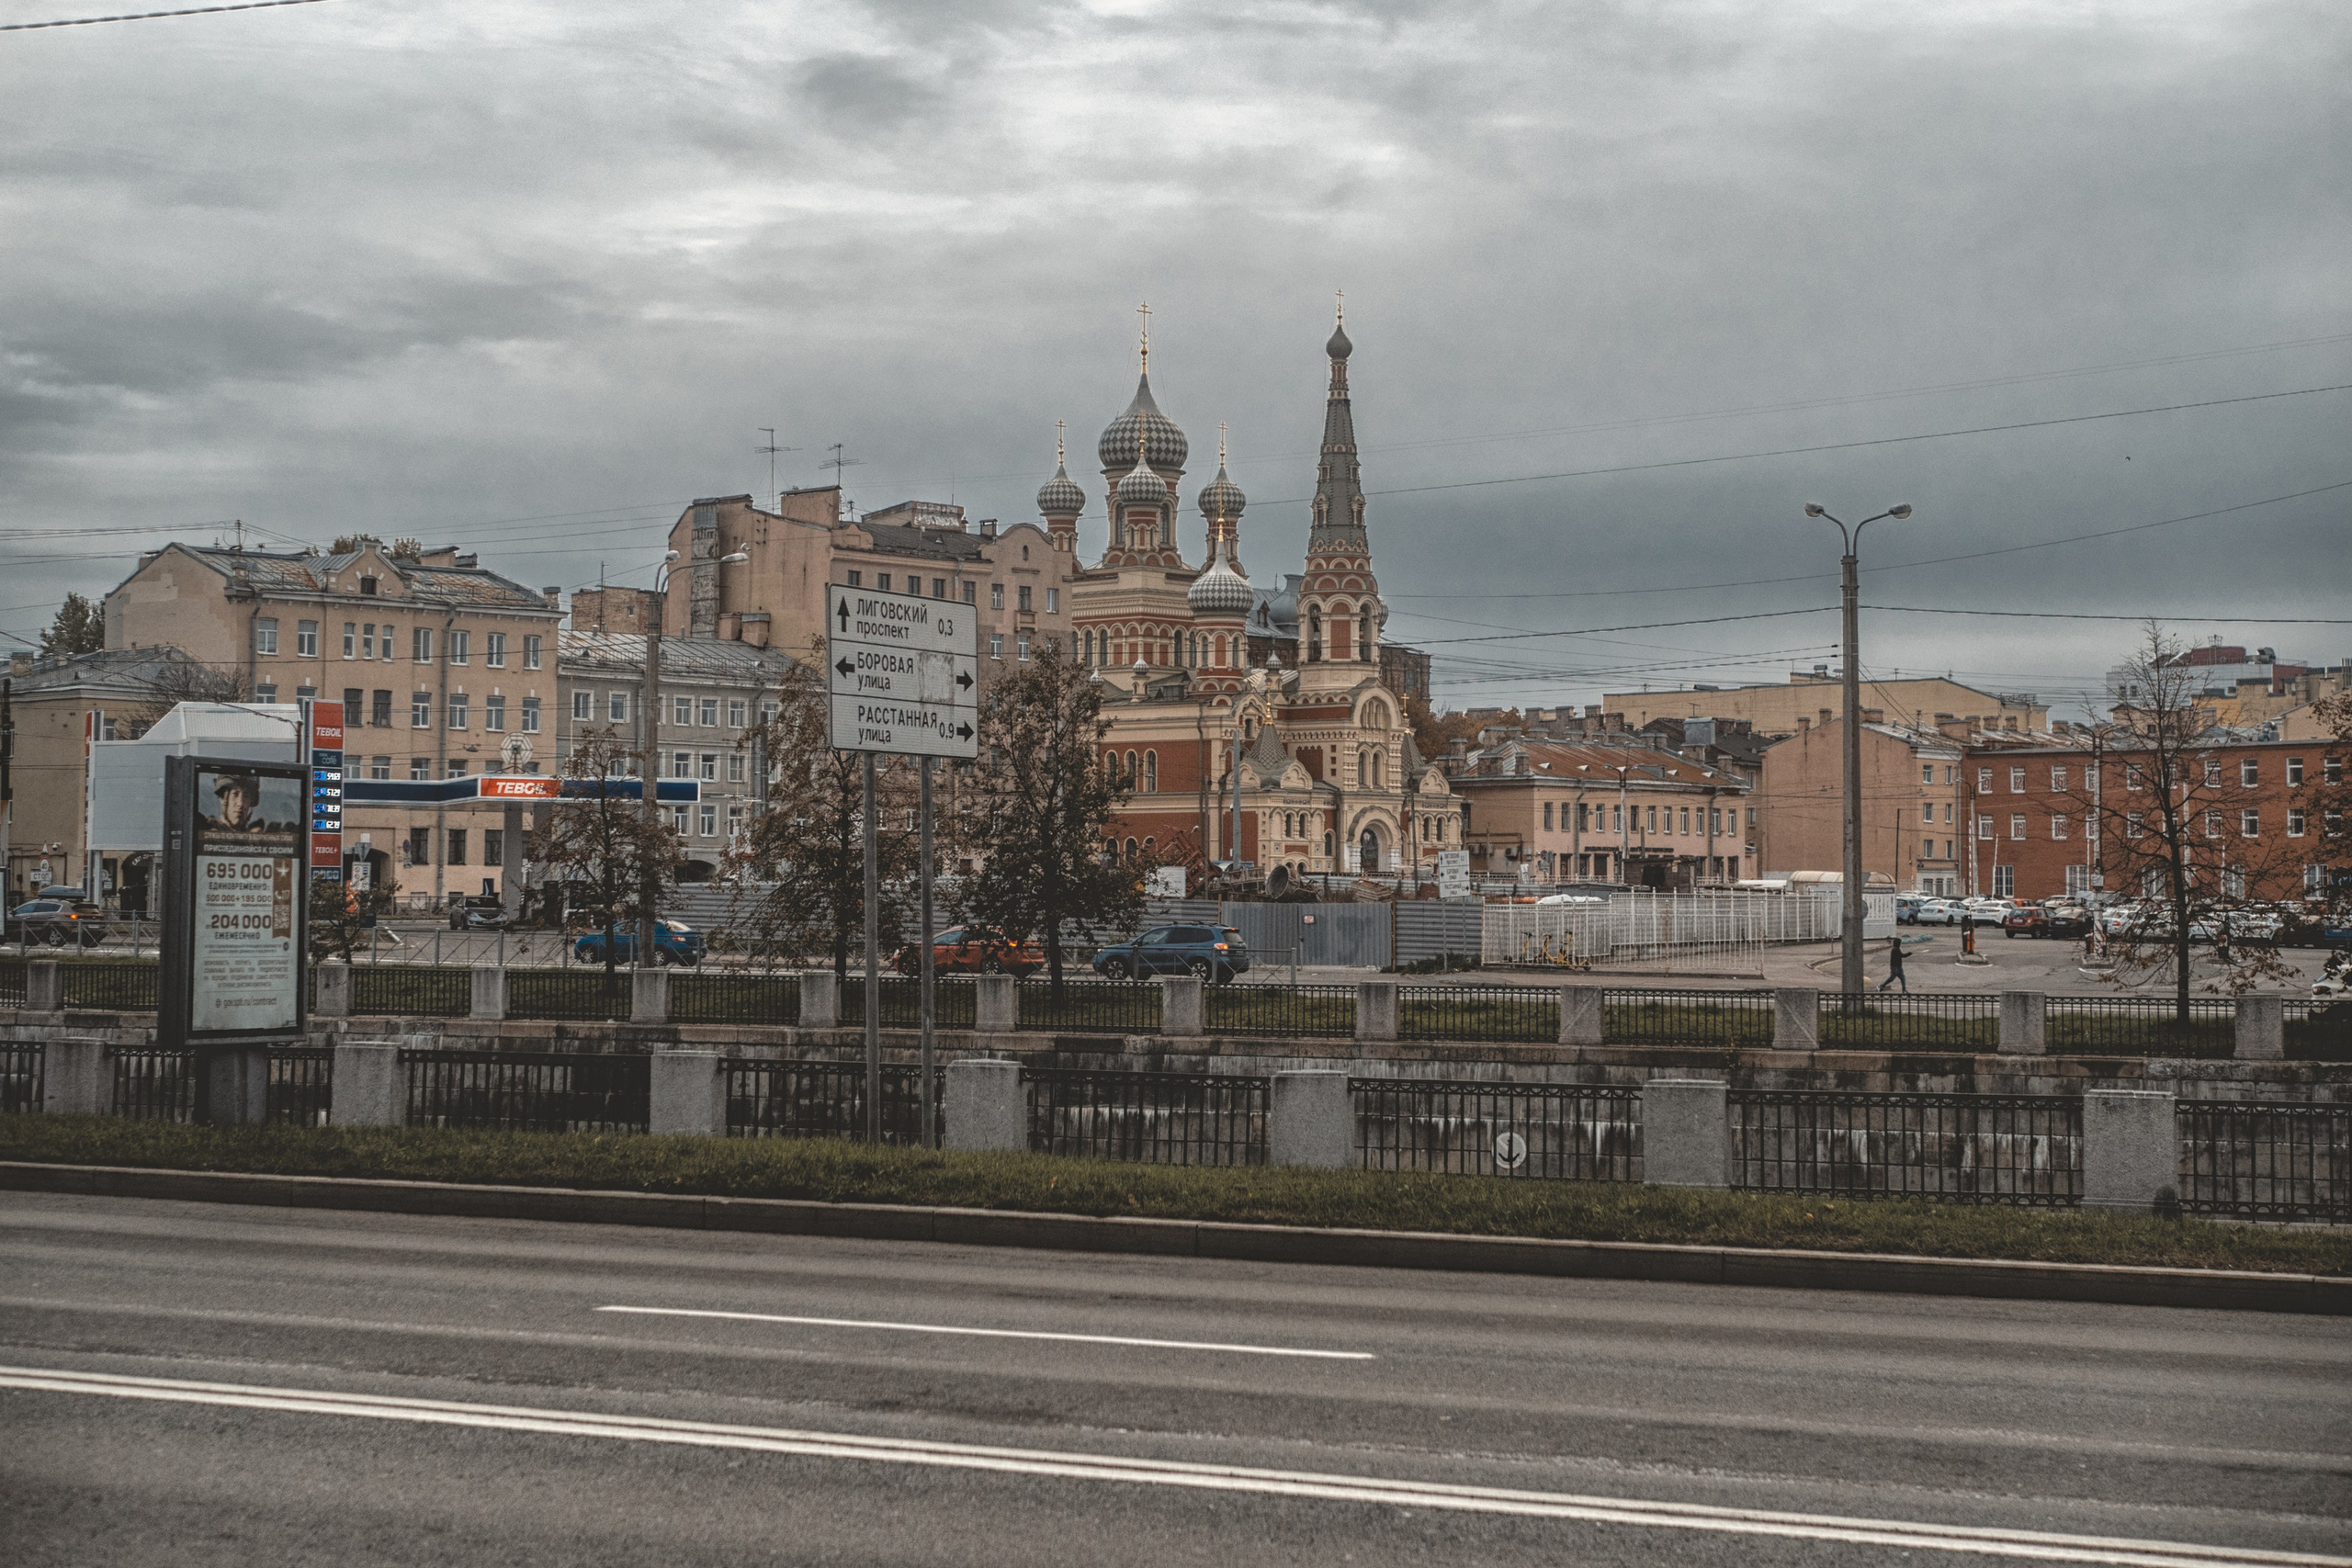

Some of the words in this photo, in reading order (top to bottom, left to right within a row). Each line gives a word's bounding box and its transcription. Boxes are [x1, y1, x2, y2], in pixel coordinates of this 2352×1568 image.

[856, 598, 928, 625] ЛИГОВСКИЙ
[856, 621, 910, 639] проспект
[938, 618, 954, 637] 0,3
[857, 651, 914, 674] БОРОВАЯ
[857, 674, 891, 692] улица
[858, 705, 938, 729] РАССТАННАЯ
[316, 727, 342, 738] TEBOIL
[858, 728, 891, 745] улица
[939, 722, 955, 740] 0,9
[207, 862, 236, 879] 695
[241, 863, 273, 880] 000
[211, 914, 239, 930] 204
[243, 914, 272, 930] 000
